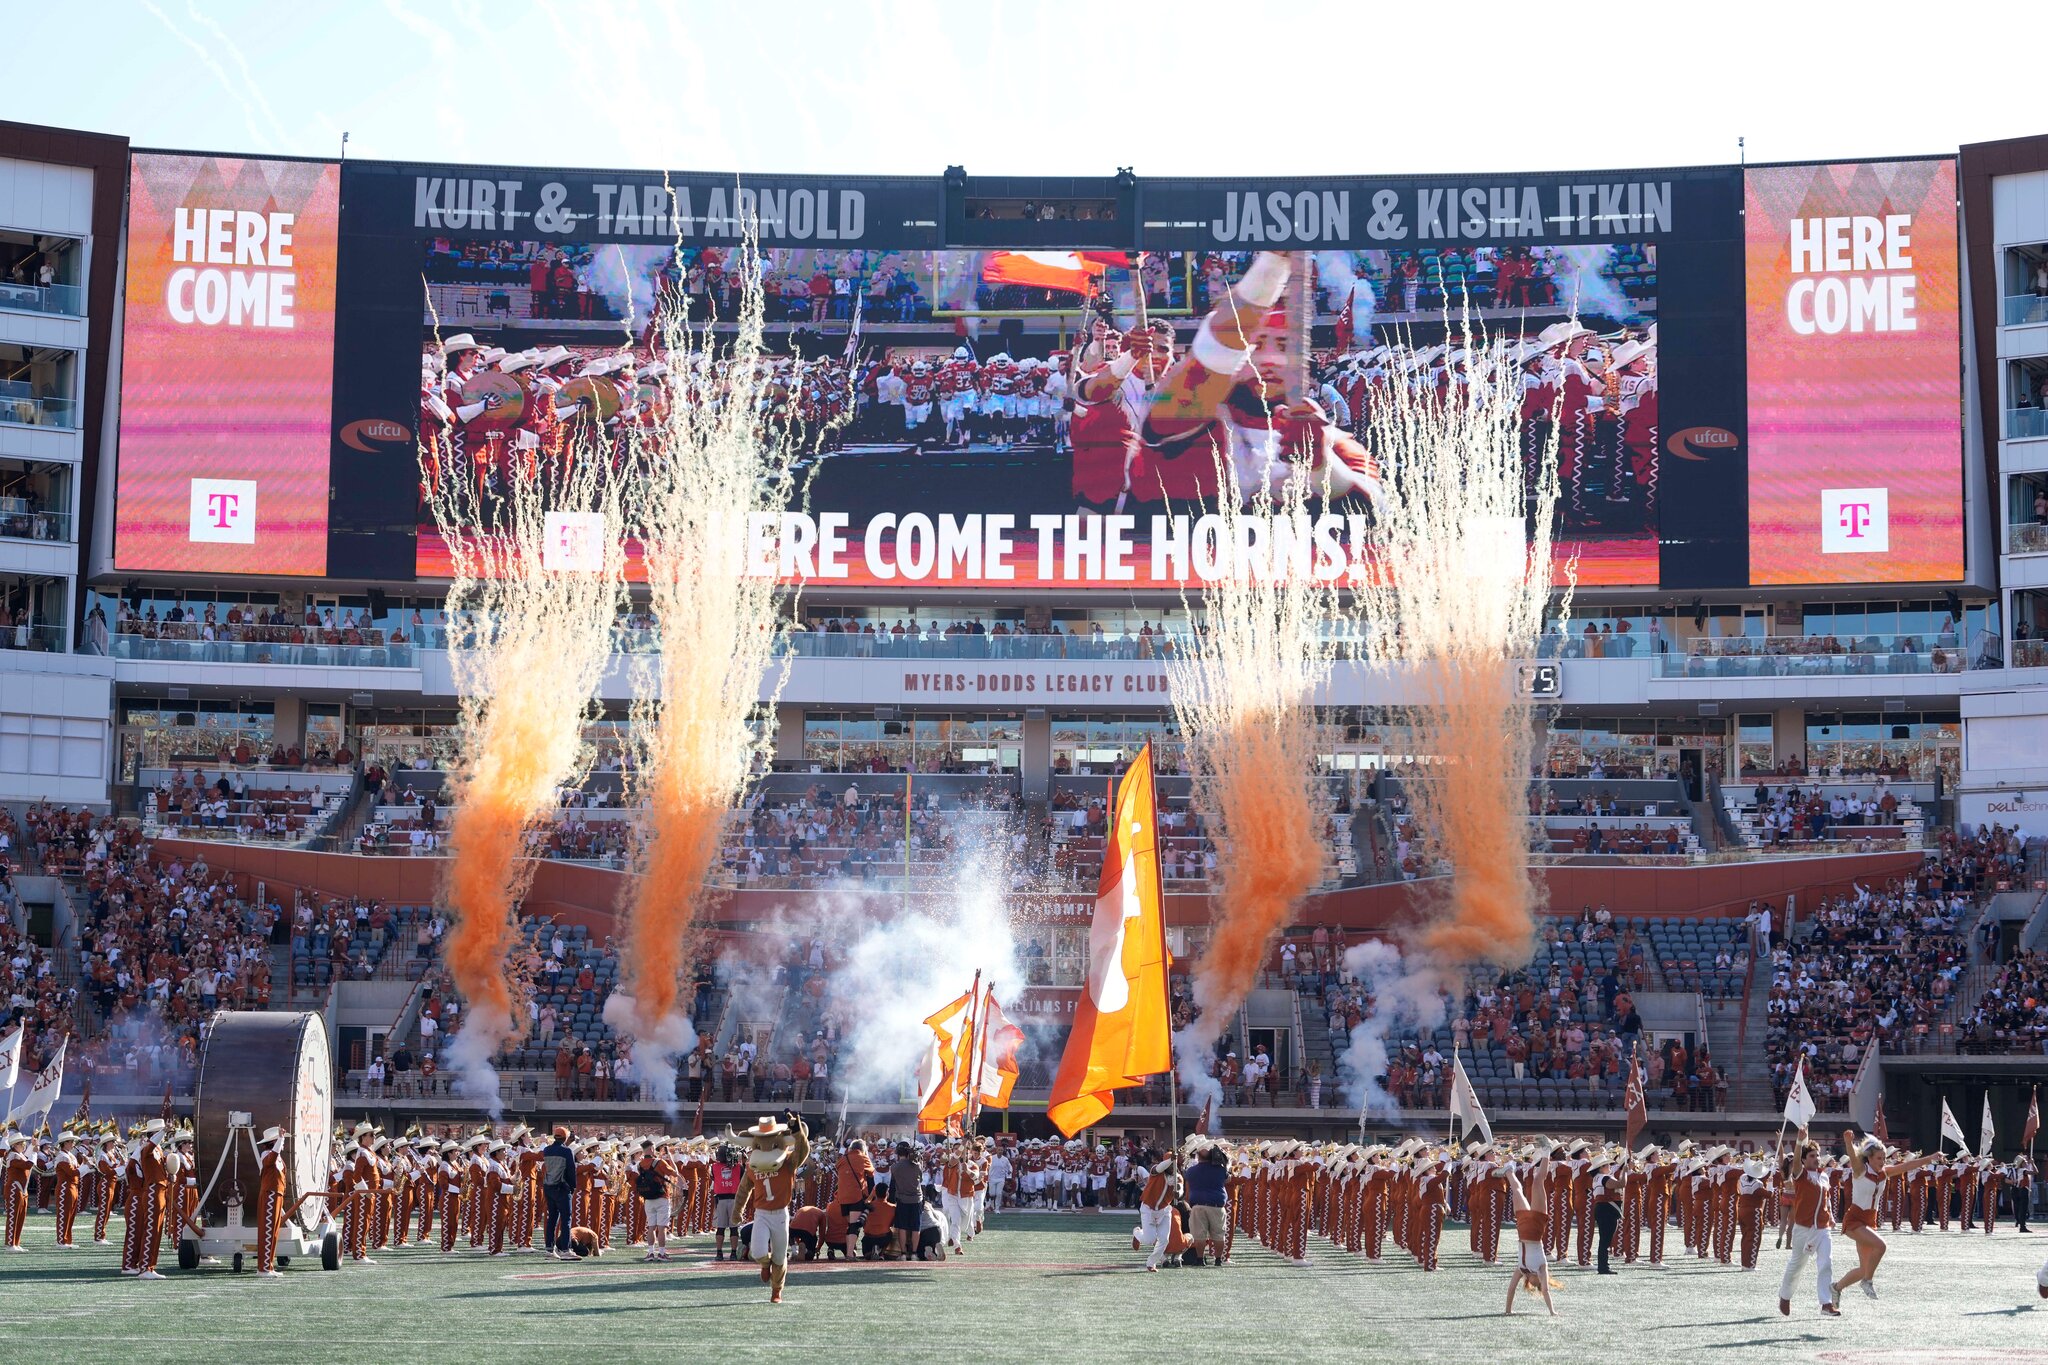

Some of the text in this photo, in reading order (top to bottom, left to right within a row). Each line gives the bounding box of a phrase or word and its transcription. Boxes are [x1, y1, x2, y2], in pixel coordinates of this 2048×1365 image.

[414, 176, 866, 241] KURT & TARA ARNOLD
[1212, 182, 1672, 242] JASON & KISHA ITKIN
[173, 207, 294, 267] HERE
[1790, 214, 1912, 273] HERE
[167, 267, 295, 328] COME
[1787, 275, 1917, 335] COME
[368, 423, 401, 437] ufcu
[1695, 430, 1728, 444] ufcu
[864, 511, 1016, 580] COME
[1030, 513, 1135, 581] THE
[1150, 513, 1368, 582] HORNS!
[904, 673, 1168, 692] MYERS-DODDS LEGACY CLUB
[1987, 802, 2018, 813] DELL
[1043, 903, 1093, 916] COMPL
[1008, 1001, 1061, 1013] ILLIAMS
[762, 1178, 774, 1201] 1
